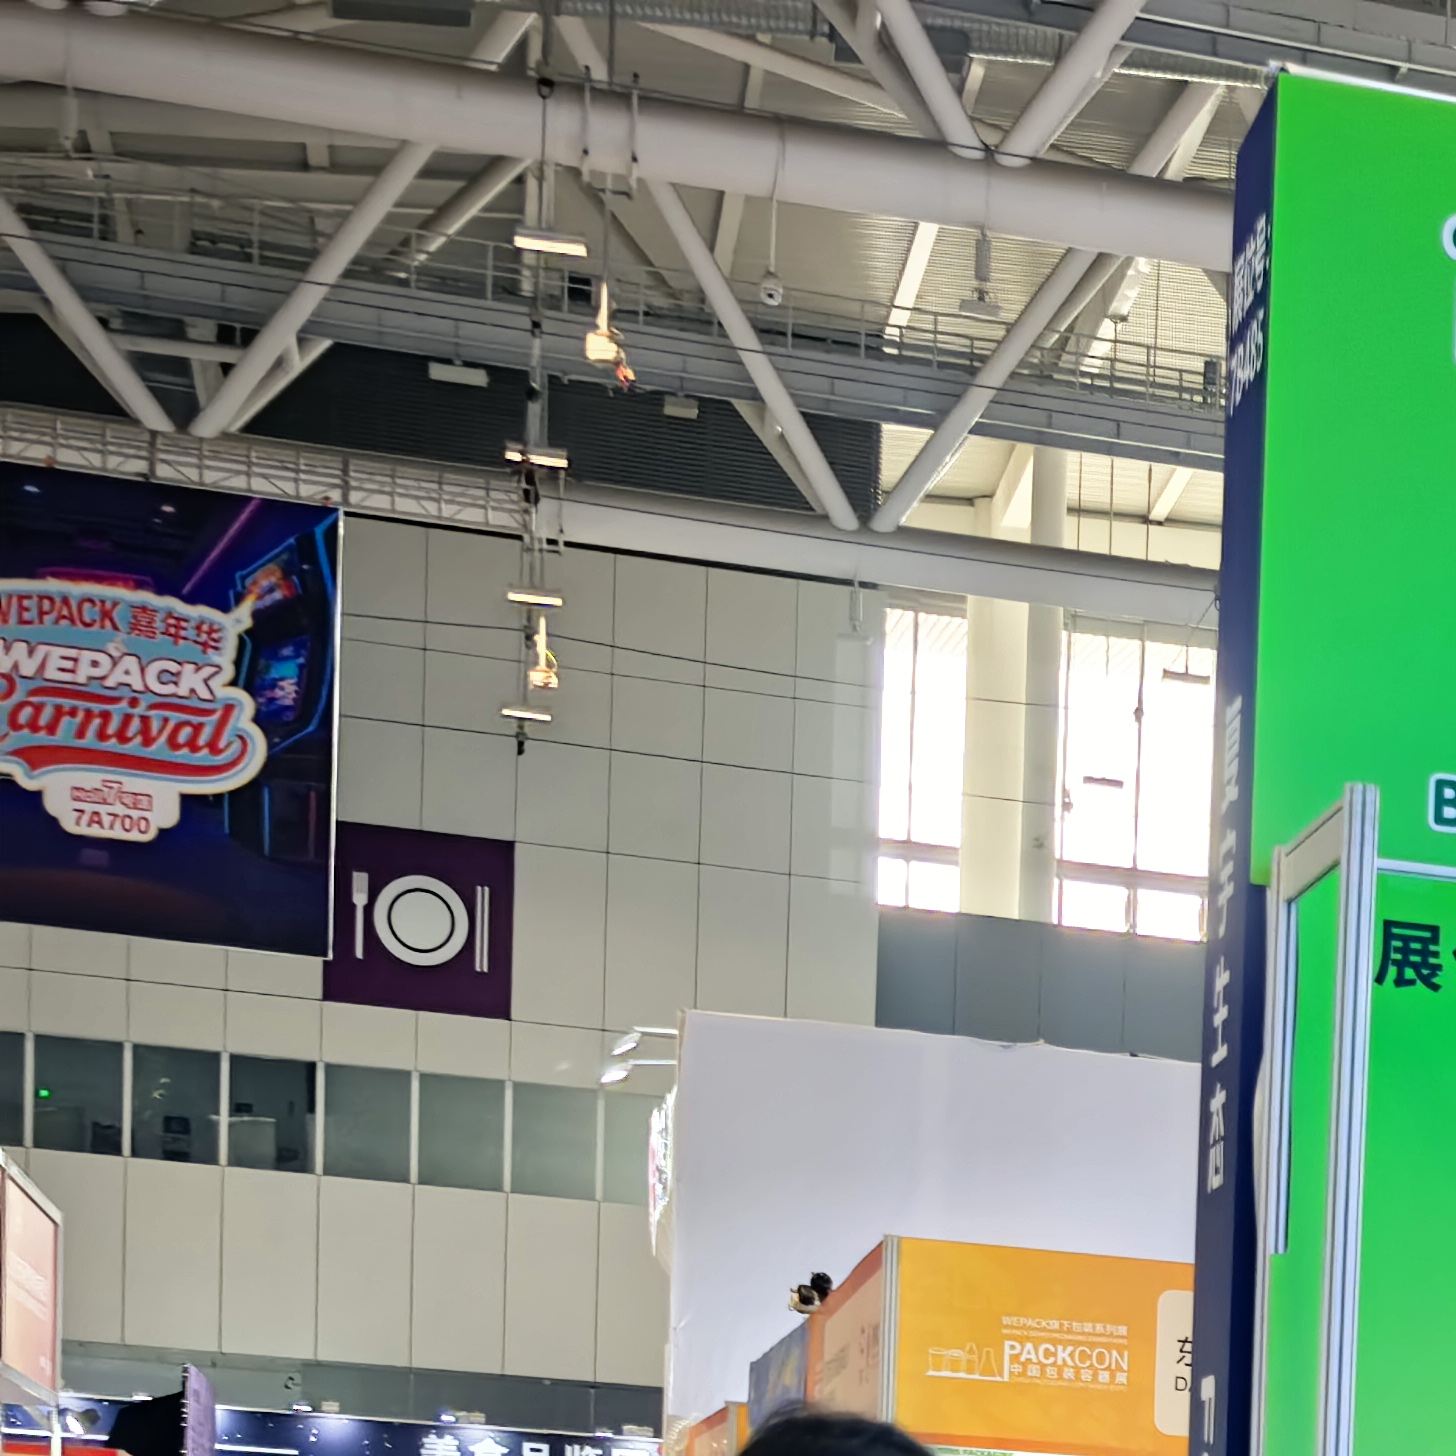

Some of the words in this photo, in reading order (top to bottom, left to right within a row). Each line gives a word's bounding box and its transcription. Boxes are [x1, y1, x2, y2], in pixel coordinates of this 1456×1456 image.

[1230, 307, 1264, 417] 7B485
[129, 604, 223, 654] 嘉年华
[73, 809, 151, 835] 7A700
[1004, 1341, 1128, 1372] PACKCON
